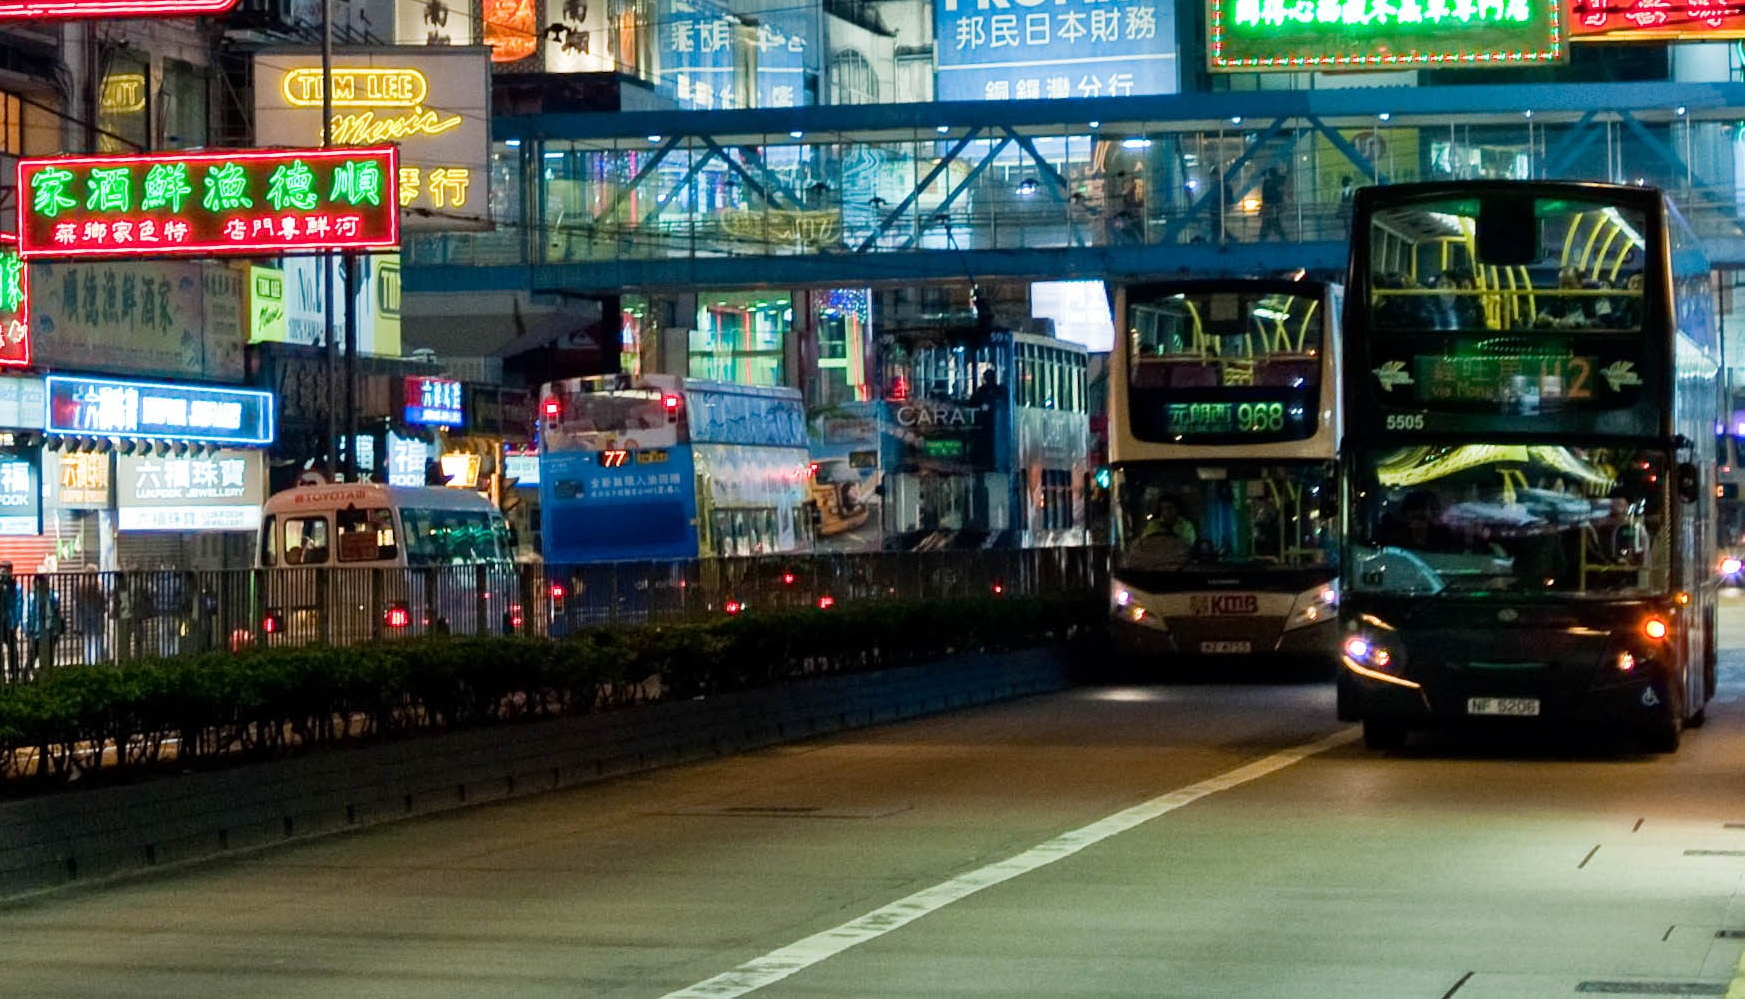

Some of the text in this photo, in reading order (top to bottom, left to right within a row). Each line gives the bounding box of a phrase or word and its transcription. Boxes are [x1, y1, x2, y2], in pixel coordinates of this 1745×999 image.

[956, 6, 1155, 50] 邦民日本財務
[367, 74, 413, 99] LEE
[1238, 403, 1284, 431] 968
[1386, 414, 1424, 430] 5505
[604, 450, 627, 468] 77
